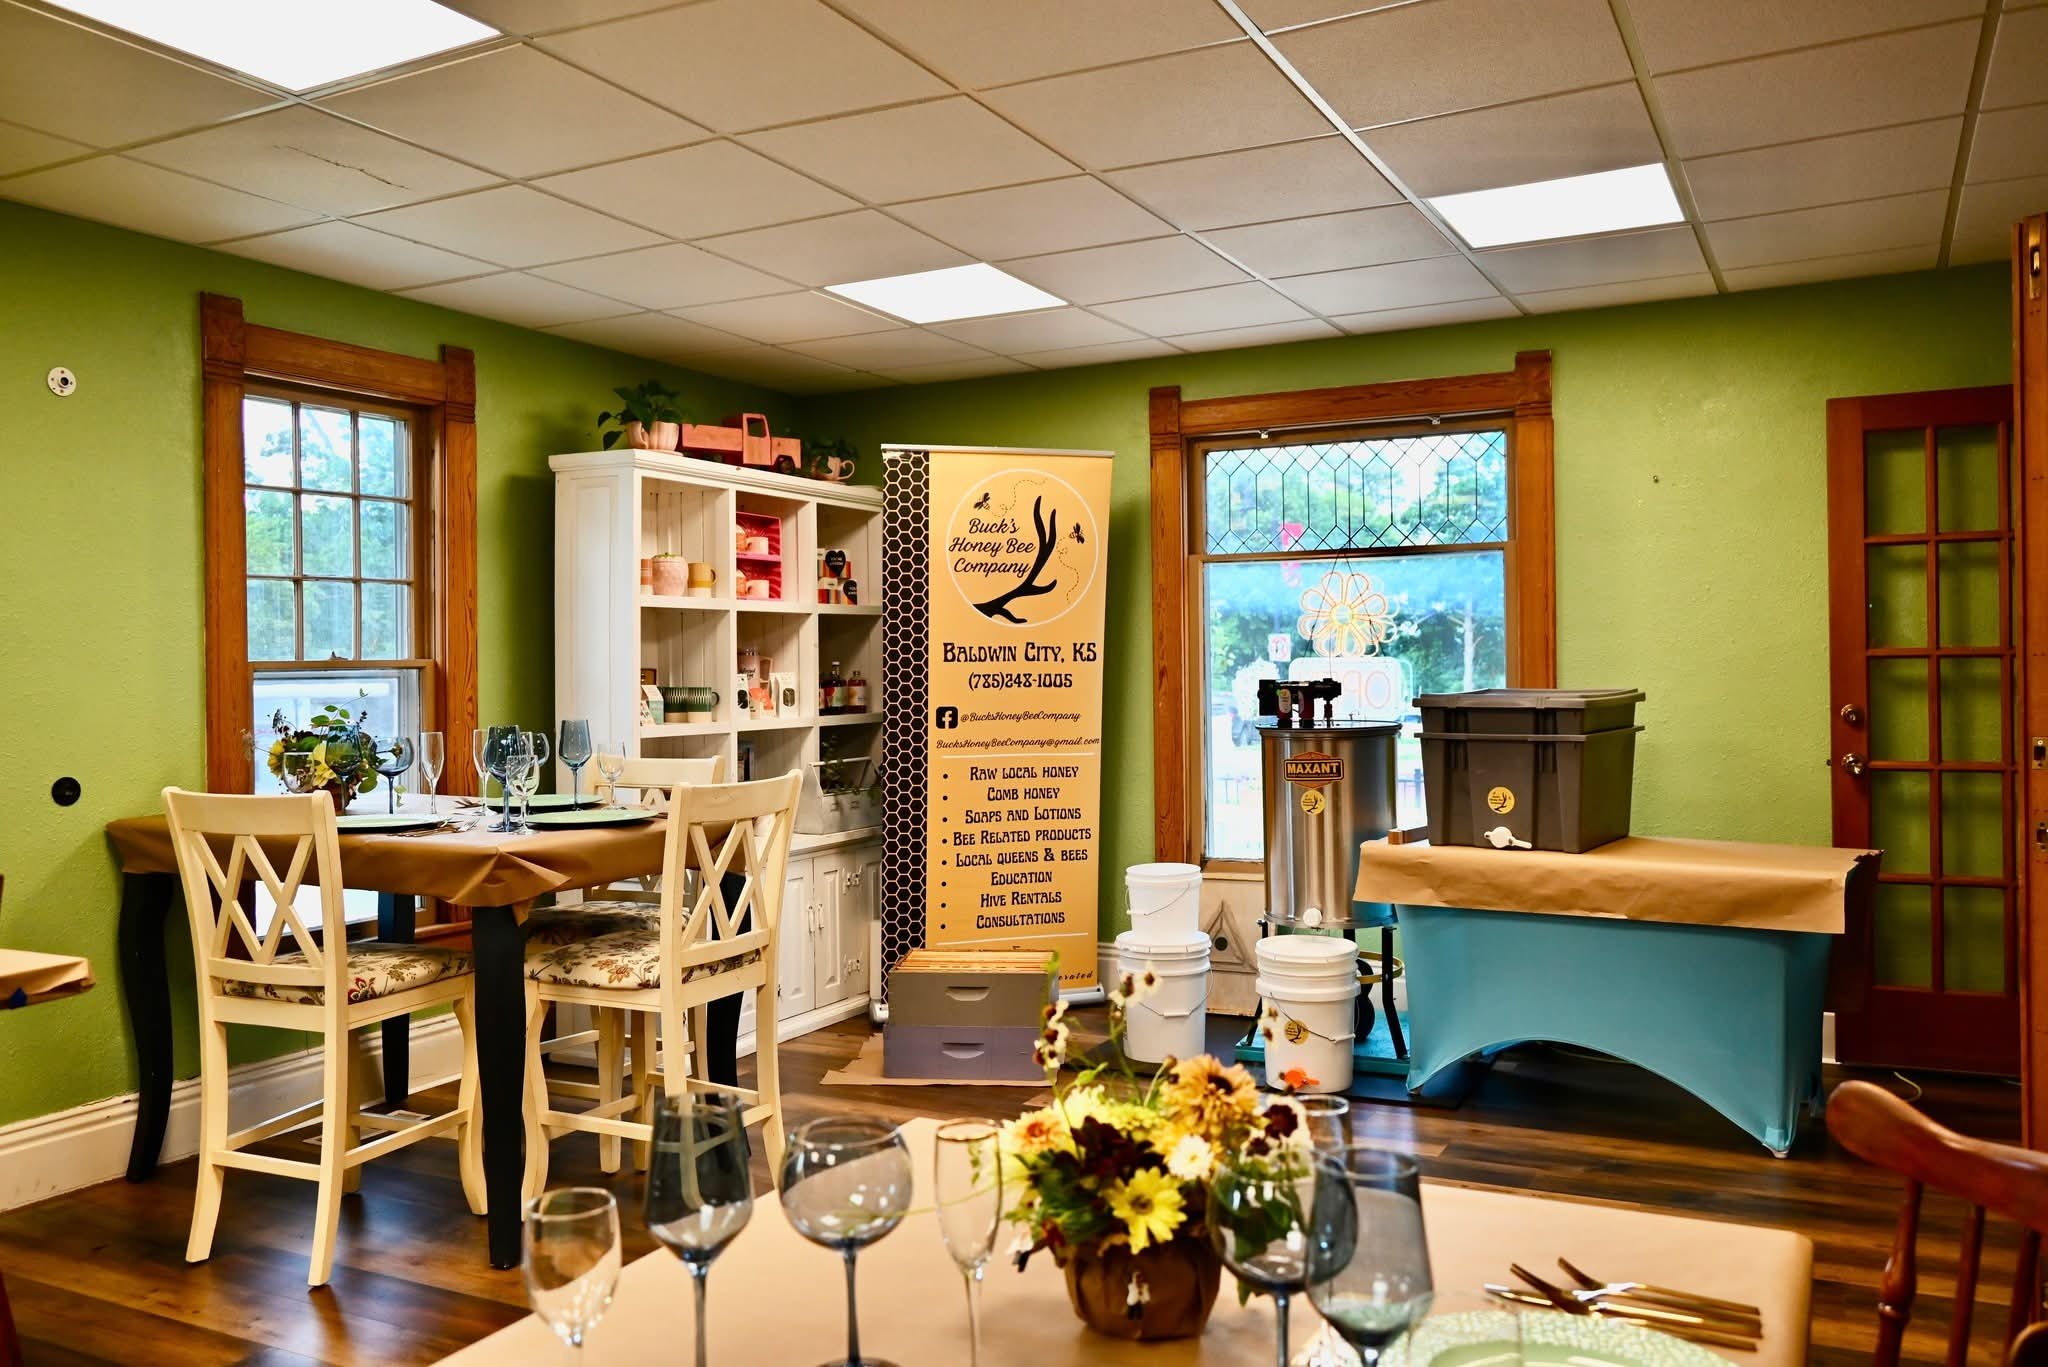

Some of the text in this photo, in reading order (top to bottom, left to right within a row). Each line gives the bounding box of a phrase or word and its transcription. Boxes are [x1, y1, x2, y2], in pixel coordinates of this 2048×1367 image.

[968, 517, 1020, 535] Buck's
[948, 537, 1037, 557] Honey Bee
[953, 557, 1031, 578] Company
[943, 641, 1098, 664] BALDWIN CITY, KS
[968, 672, 1073, 691] (785)248-1005
[960, 710, 1081, 723] @BucksHoneyBeeCompany
[936, 736, 1100, 750] BucksHoneyBeeCompany@gmail.com
[1287, 762, 1340, 774] MAXANT
[1043, 847, 1055, 862] &
[1058, 970, 1094, 981] erated
